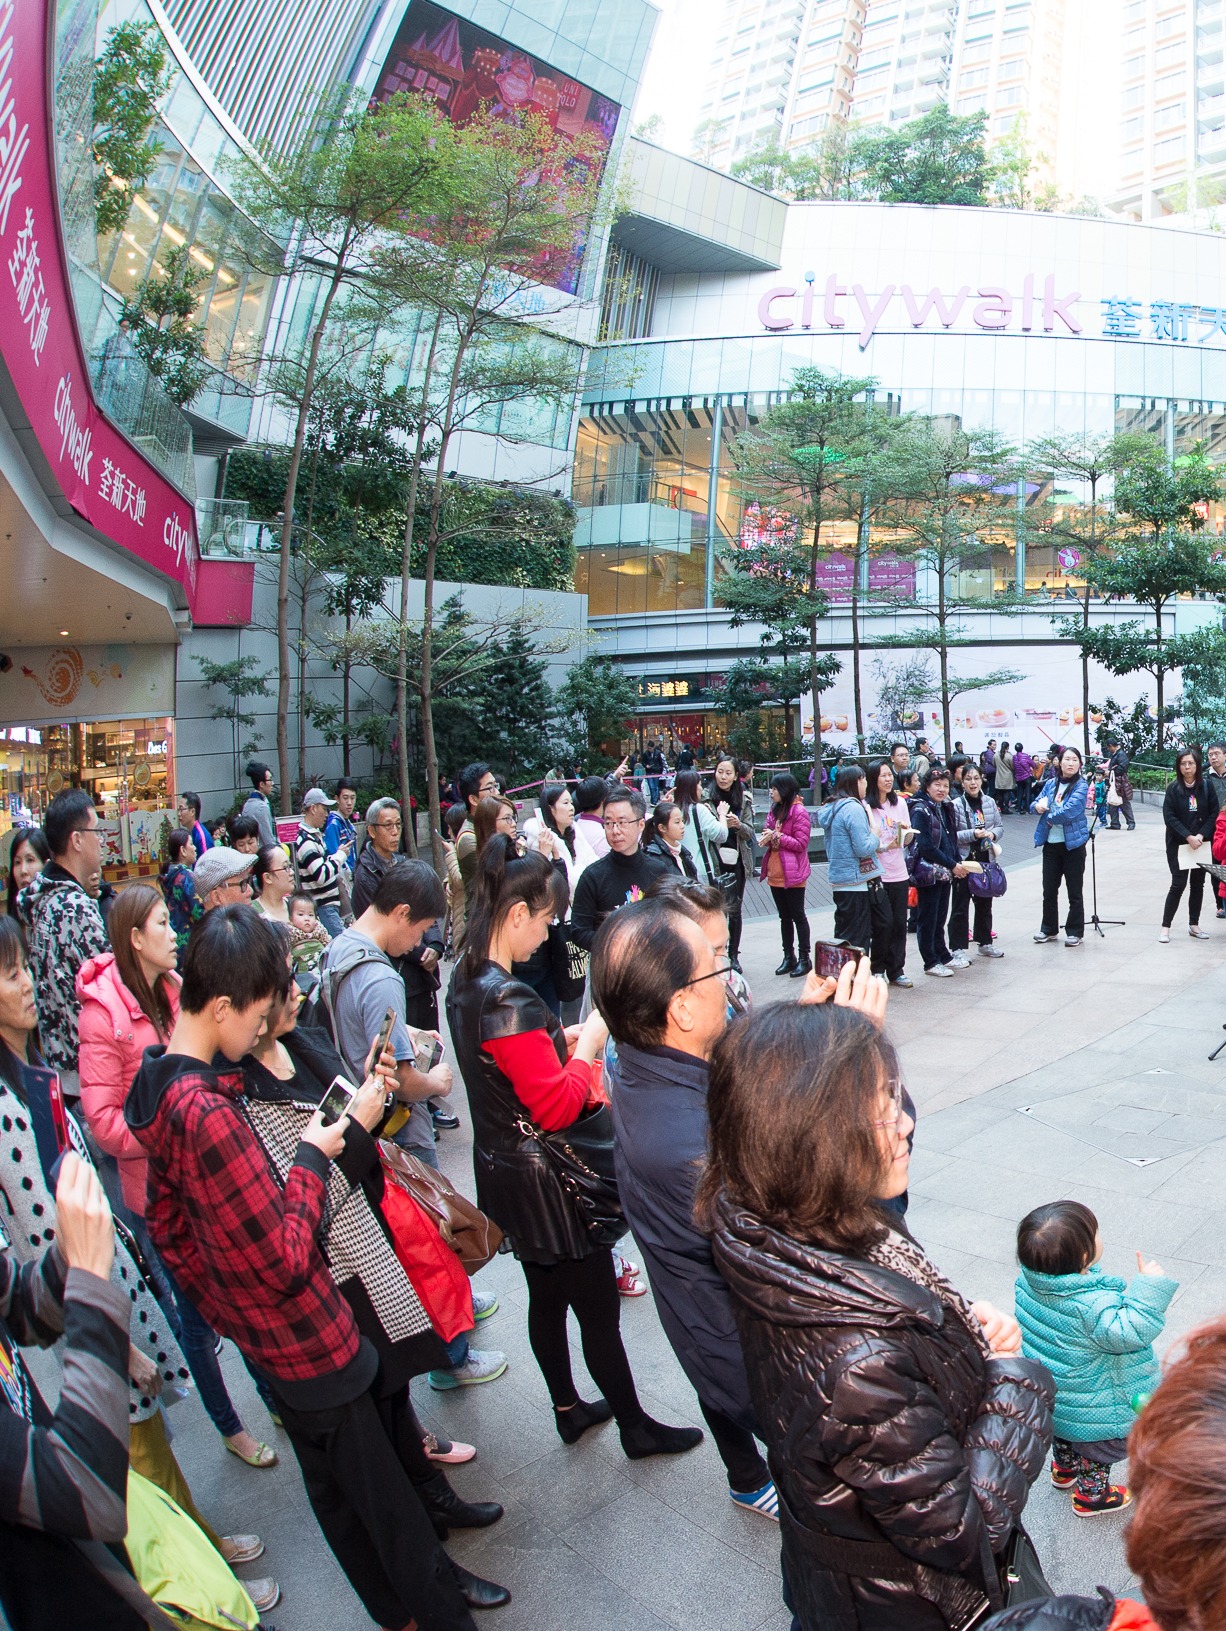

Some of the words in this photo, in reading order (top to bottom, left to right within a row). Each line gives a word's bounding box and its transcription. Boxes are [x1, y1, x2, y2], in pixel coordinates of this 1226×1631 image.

[8, 206, 51, 367] 荃新天地
[757, 270, 1083, 352] citywalk
[54, 372, 93, 486] citywalk
[98, 457, 147, 527] 荃新天地
